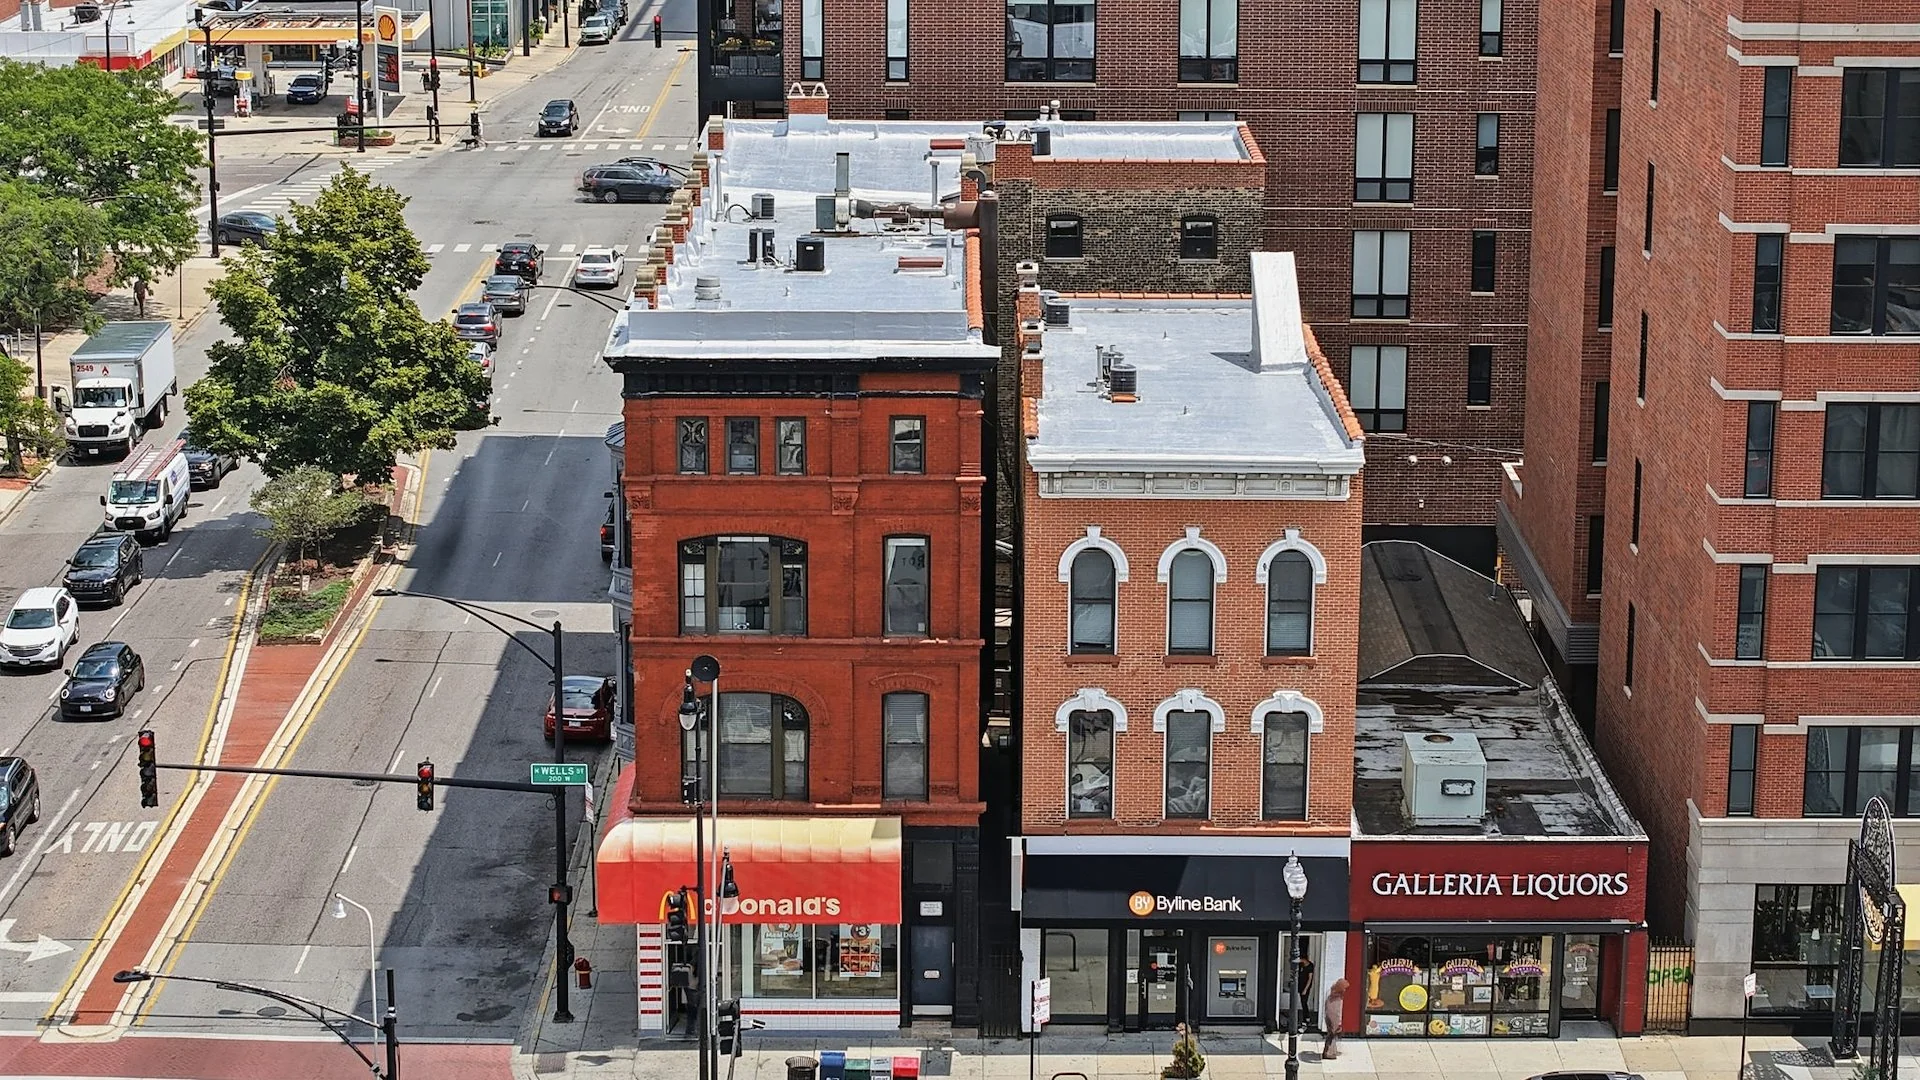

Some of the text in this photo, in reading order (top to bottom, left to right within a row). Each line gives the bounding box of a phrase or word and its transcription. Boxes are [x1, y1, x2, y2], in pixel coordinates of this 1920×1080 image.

[607, 105, 651, 113] ONLY
[76, 365, 94, 373] 2549
[541, 766, 575, 775] WELLS
[44, 821, 159, 853] ONLY
[1372, 872, 1629, 901] GALLERIA LIQUORS
[1134, 895, 1243, 914] BY Byline Bank
[1381, 958, 1413, 970] GALLERIA
